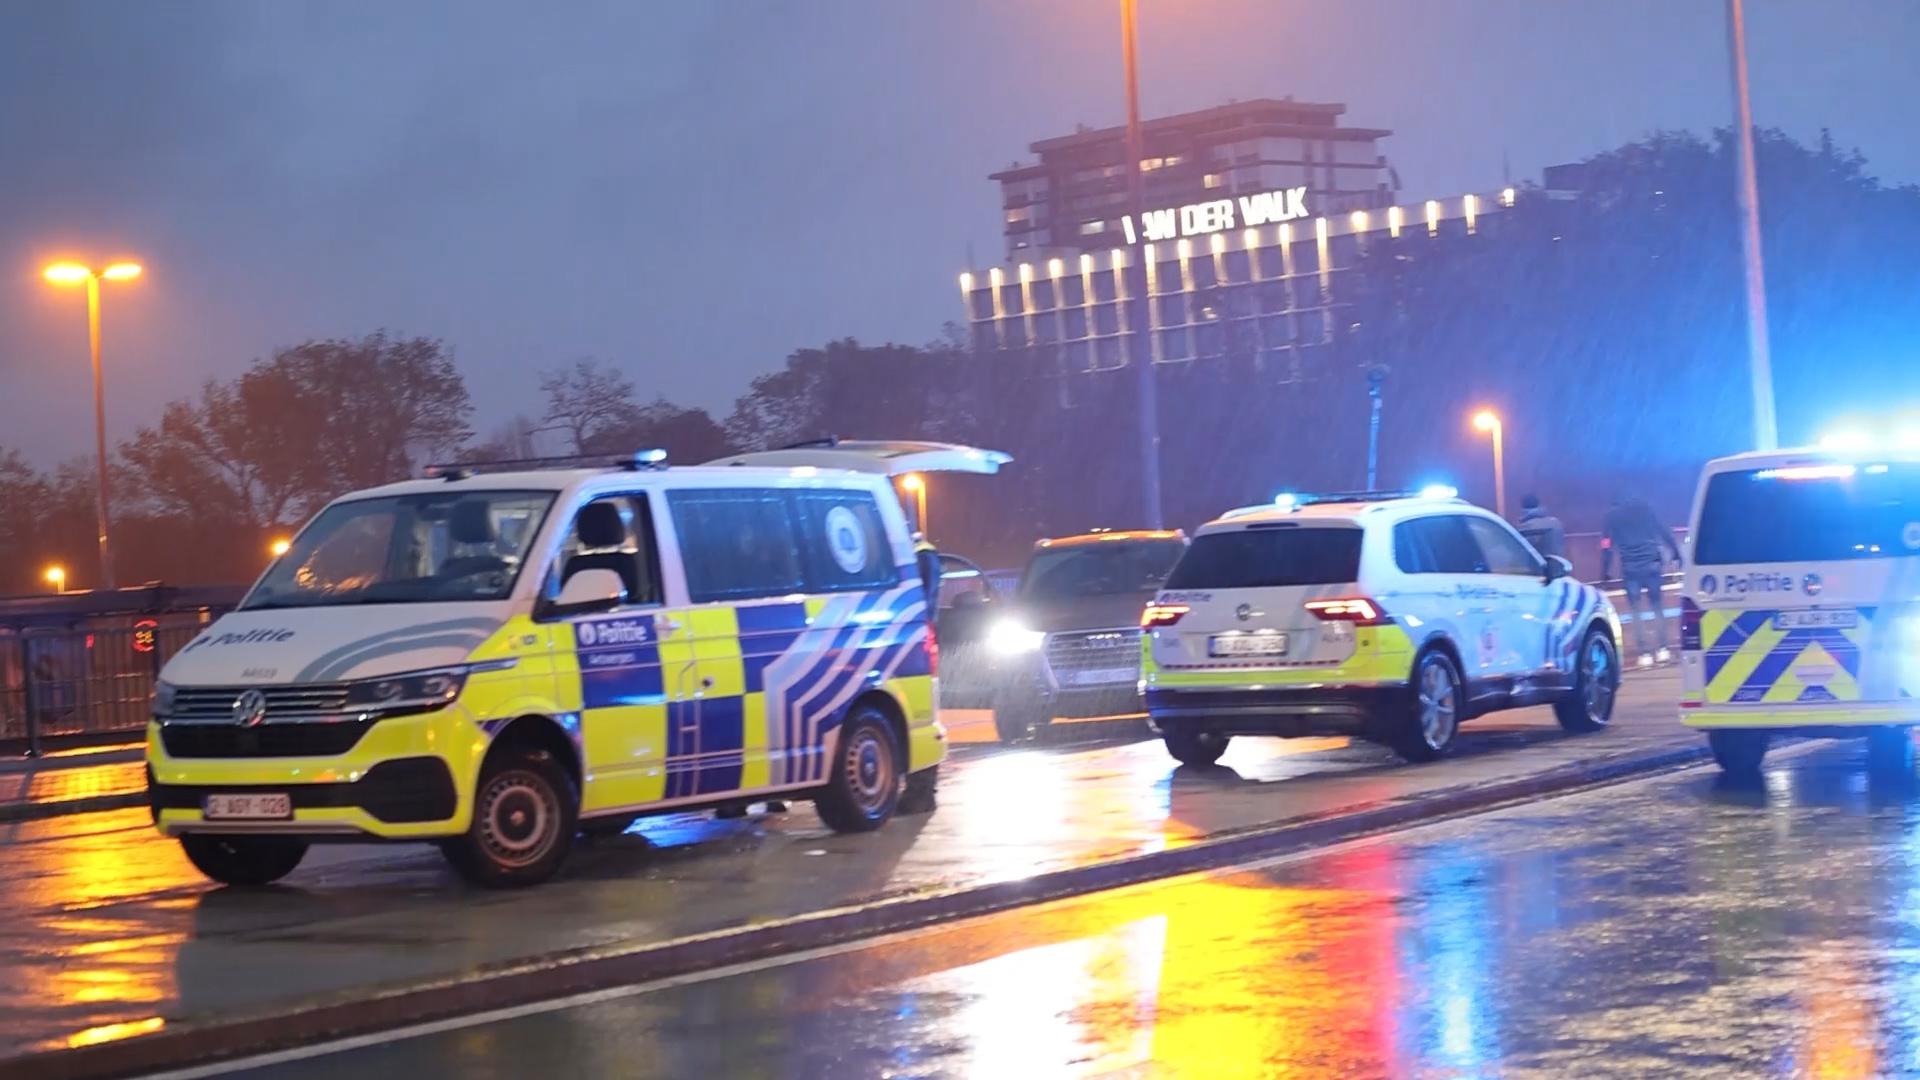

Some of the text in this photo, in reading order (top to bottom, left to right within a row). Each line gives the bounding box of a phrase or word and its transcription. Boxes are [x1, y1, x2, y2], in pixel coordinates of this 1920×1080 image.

[1180, 199, 1234, 236] DER
[1238, 186, 1309, 226] VALK
[1724, 572, 1793, 594] Politie
[208, 628, 295, 648] Politie
[597, 620, 648, 644] Politie
